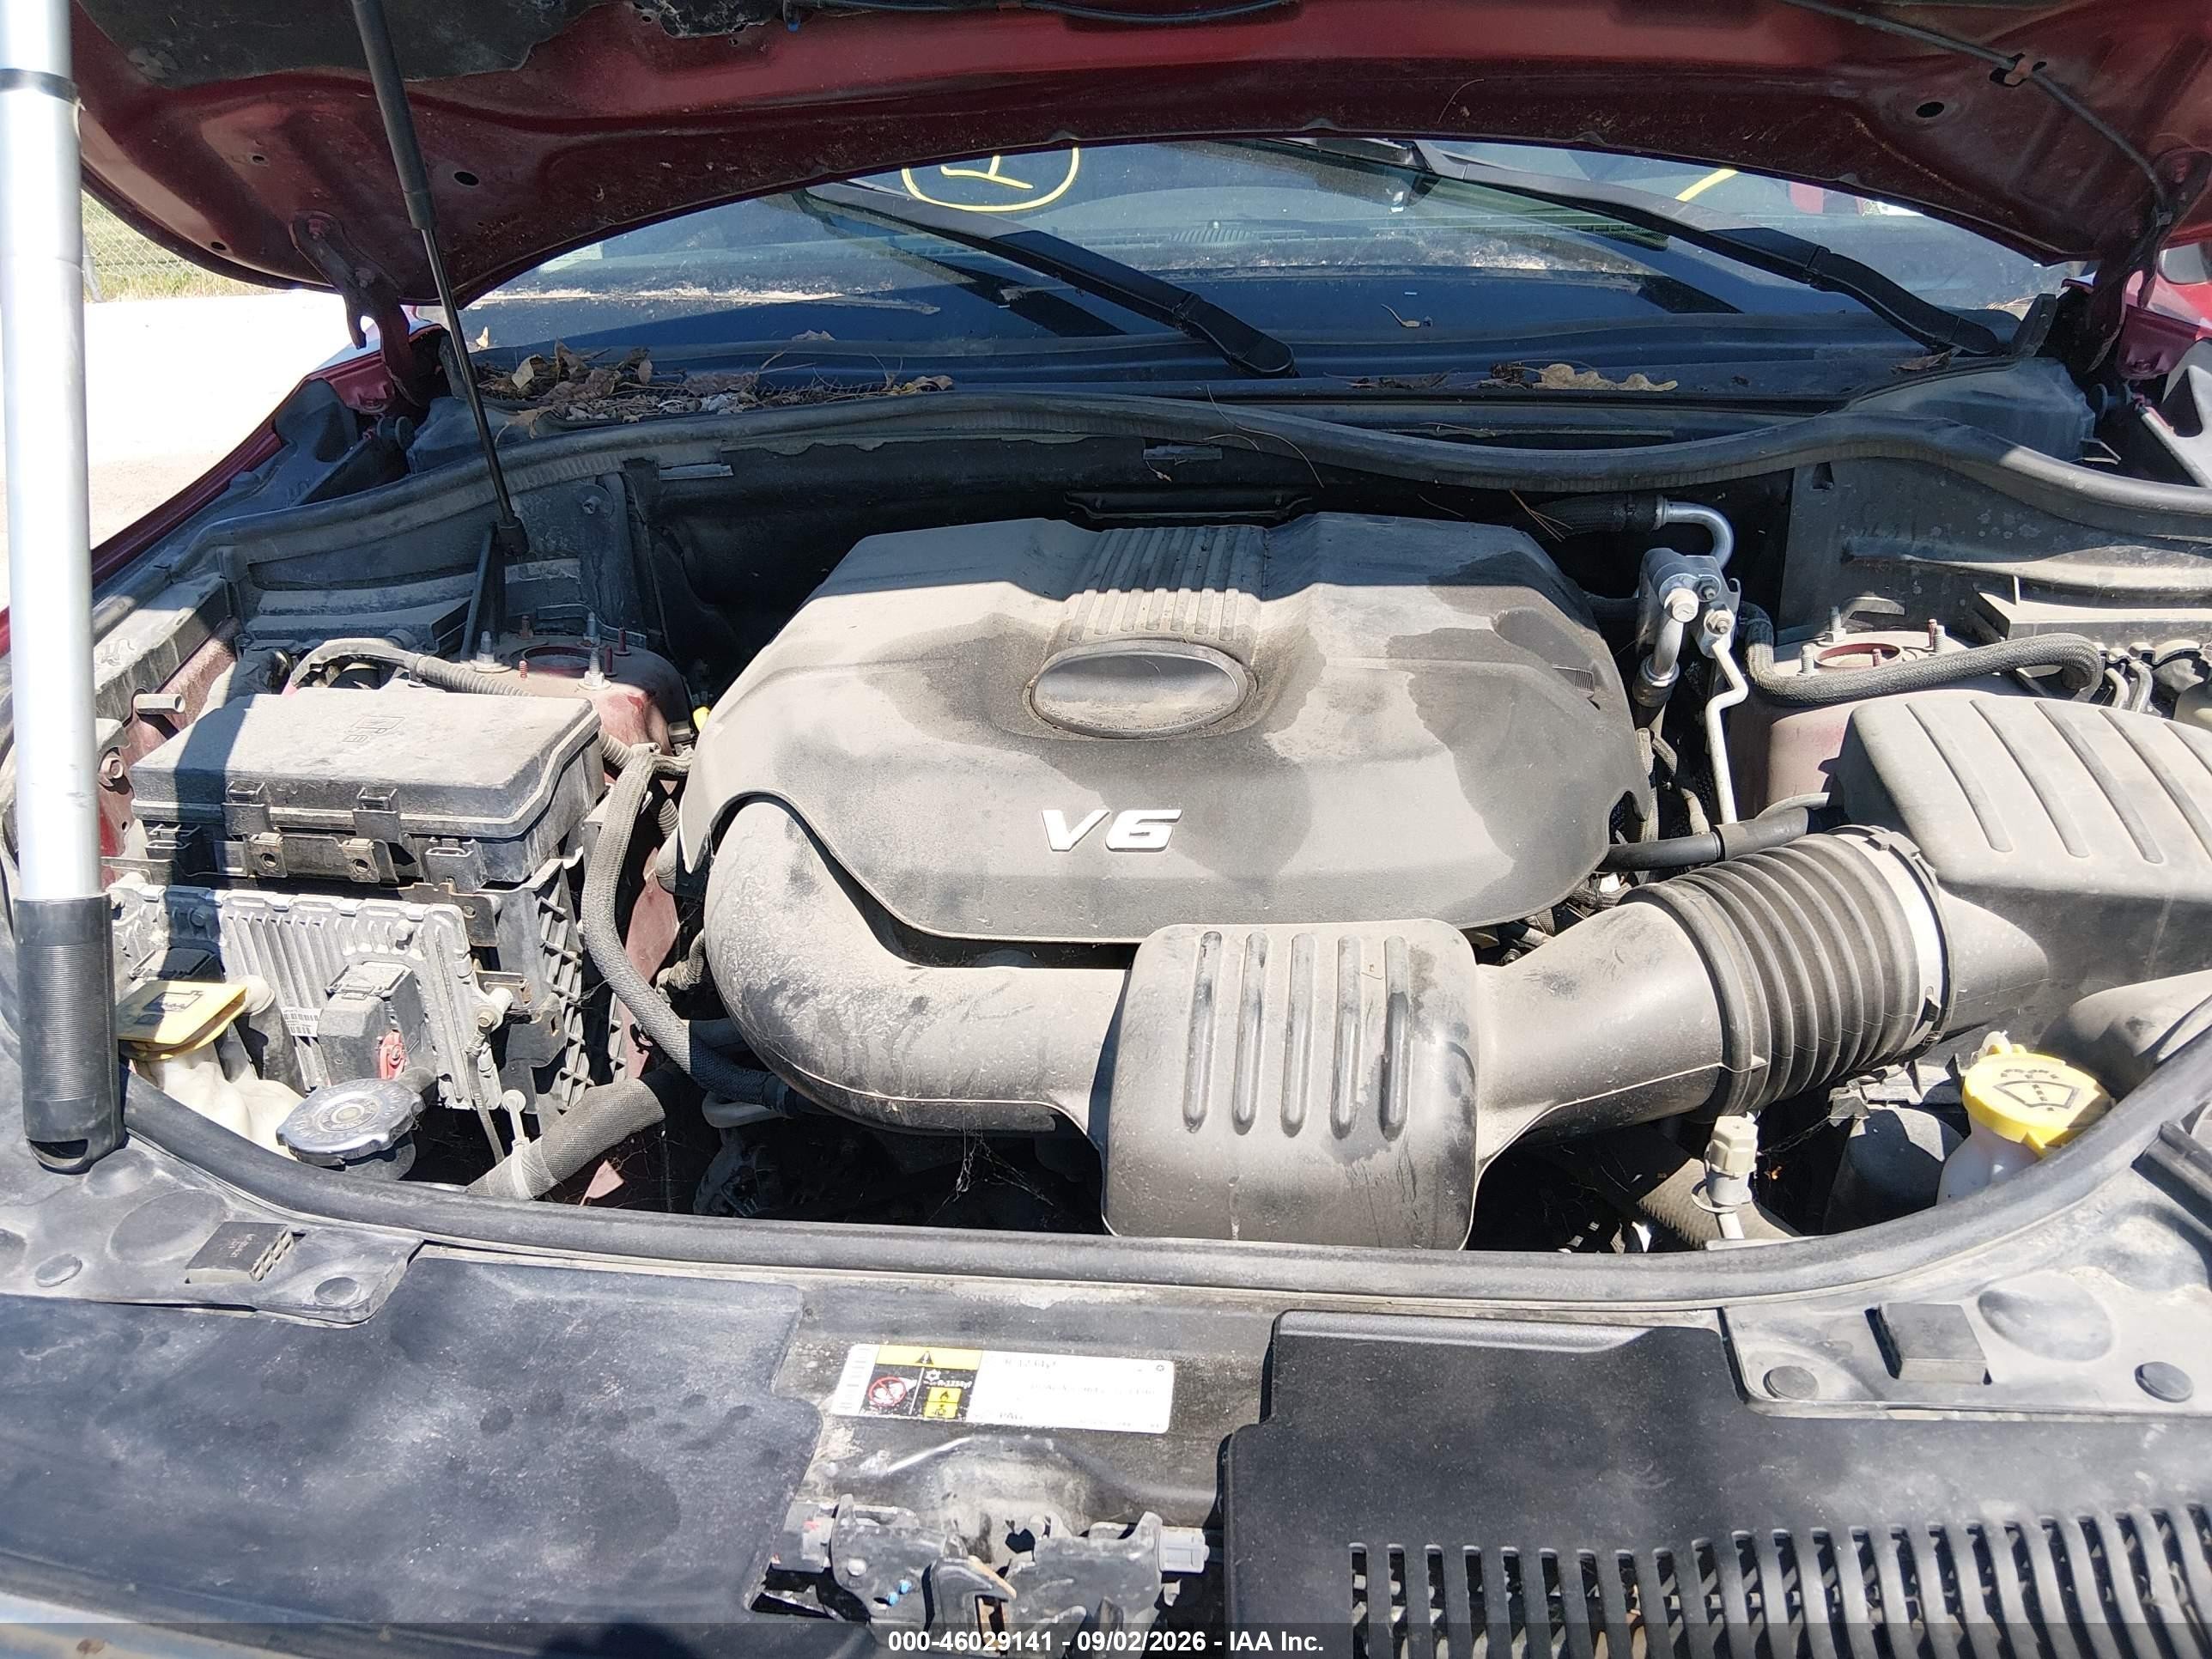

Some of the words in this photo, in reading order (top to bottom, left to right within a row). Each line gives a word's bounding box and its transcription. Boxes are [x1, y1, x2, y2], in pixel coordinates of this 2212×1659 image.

[1076, 720, 1103, 728] FOR
[1134, 720, 1181, 730] FILTER
[1042, 809, 1182, 853] V6
